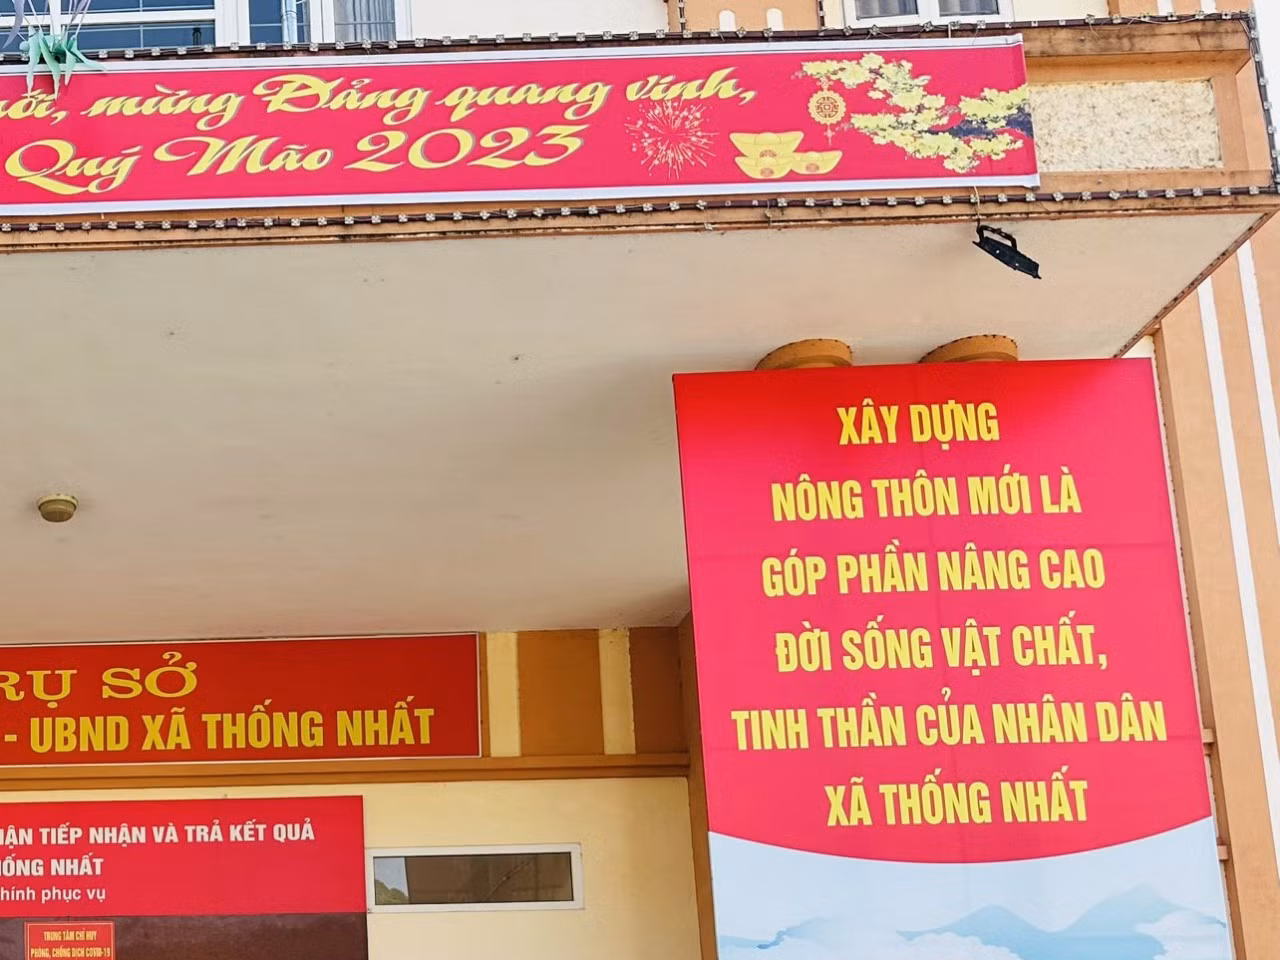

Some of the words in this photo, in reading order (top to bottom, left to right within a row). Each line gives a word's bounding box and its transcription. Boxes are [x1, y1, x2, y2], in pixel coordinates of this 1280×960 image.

[81, 84, 244, 131] mừng
[253, 73, 431, 125] Đảng
[435, 81, 613, 122] quang
[626, 67, 757, 105] vinh,
[5, 139, 143, 195] Quý
[154, 135, 333, 176] Mão
[344, 125, 591, 172] 2023
[837, 398, 899, 445] XÂY
[910, 400, 1000, 451] DỰNG
[771, 473, 864, 521] NÔNG
[872, 469, 959, 518] THÔN
[968, 463, 1031, 515] MỚI
[1040, 466, 1082, 514] LÀ
[762, 549, 827, 597] GÓP
[837, 539, 929, 594] PHẦN
[938, 542, 1030, 591] NÂNG
[1039, 549, 1105, 589] CAO
[775, 621, 830, 672] ĐỜI
[842, 614, 933, 670] SỐNG
[940, 618, 1001, 676] VẬT
[1012, 610, 1108, 670] CHẤT,
[102, 652, 197, 698] SỞ
[30, 714, 129, 752] UBND
[141, 707, 191, 750] XÃ
[201, 699, 324, 749] THỐNG
[336, 696, 434, 746] NHẤT
[731, 707, 809, 750] TINH
[817, 692, 906, 748] THẦN
[916, 687, 984, 746] CỦA
[992, 694, 1088, 744] NHÂN
[1096, 692, 1168, 742] DÂN
[824, 776, 872, 826] XÃ
[879, 768, 992, 825] THỐNG
[1000, 766, 1088, 823] NHẤT
[39, 822, 83, 844] TIẾP
[89, 823, 146, 847] NHẬN
[153, 822, 179, 843] VÀ
[184, 819, 223, 842] TRẢ
[230, 819, 266, 841] KẾT
[273, 818, 315, 842] QUẢ
[51, 852, 103, 875] NHẤT
[42, 886, 81, 904] phục
[87, 889, 106, 902] vụ
